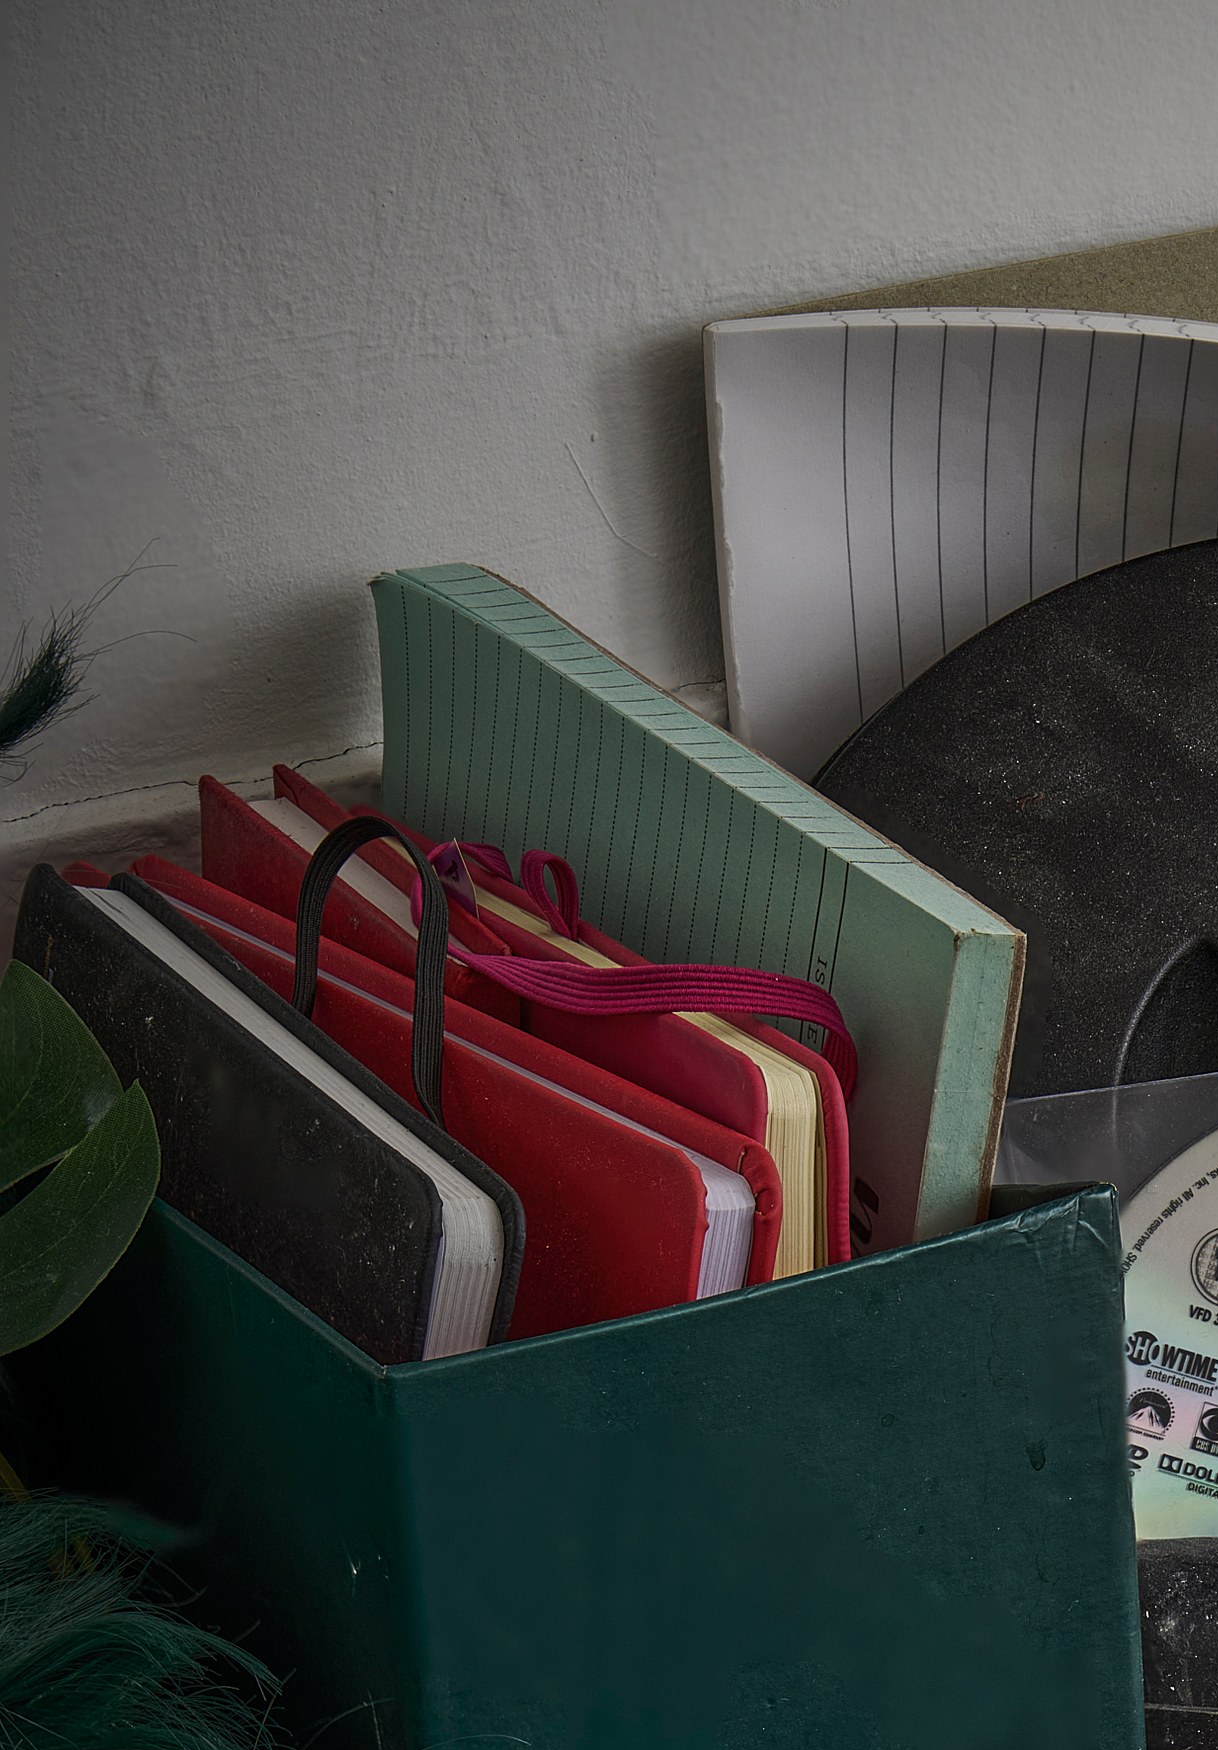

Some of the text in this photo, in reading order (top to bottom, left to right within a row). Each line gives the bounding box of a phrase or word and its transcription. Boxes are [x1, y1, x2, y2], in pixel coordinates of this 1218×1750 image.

[1193, 1176, 1210, 1190] Inc.
[1182, 1188, 1197, 1201] All
[1161, 1196, 1184, 1219] rights
[1132, 1216, 1164, 1252] reserved.
[1189, 1305, 1212, 1323] VFD
[1146, 1370, 1215, 1397] entertainment
